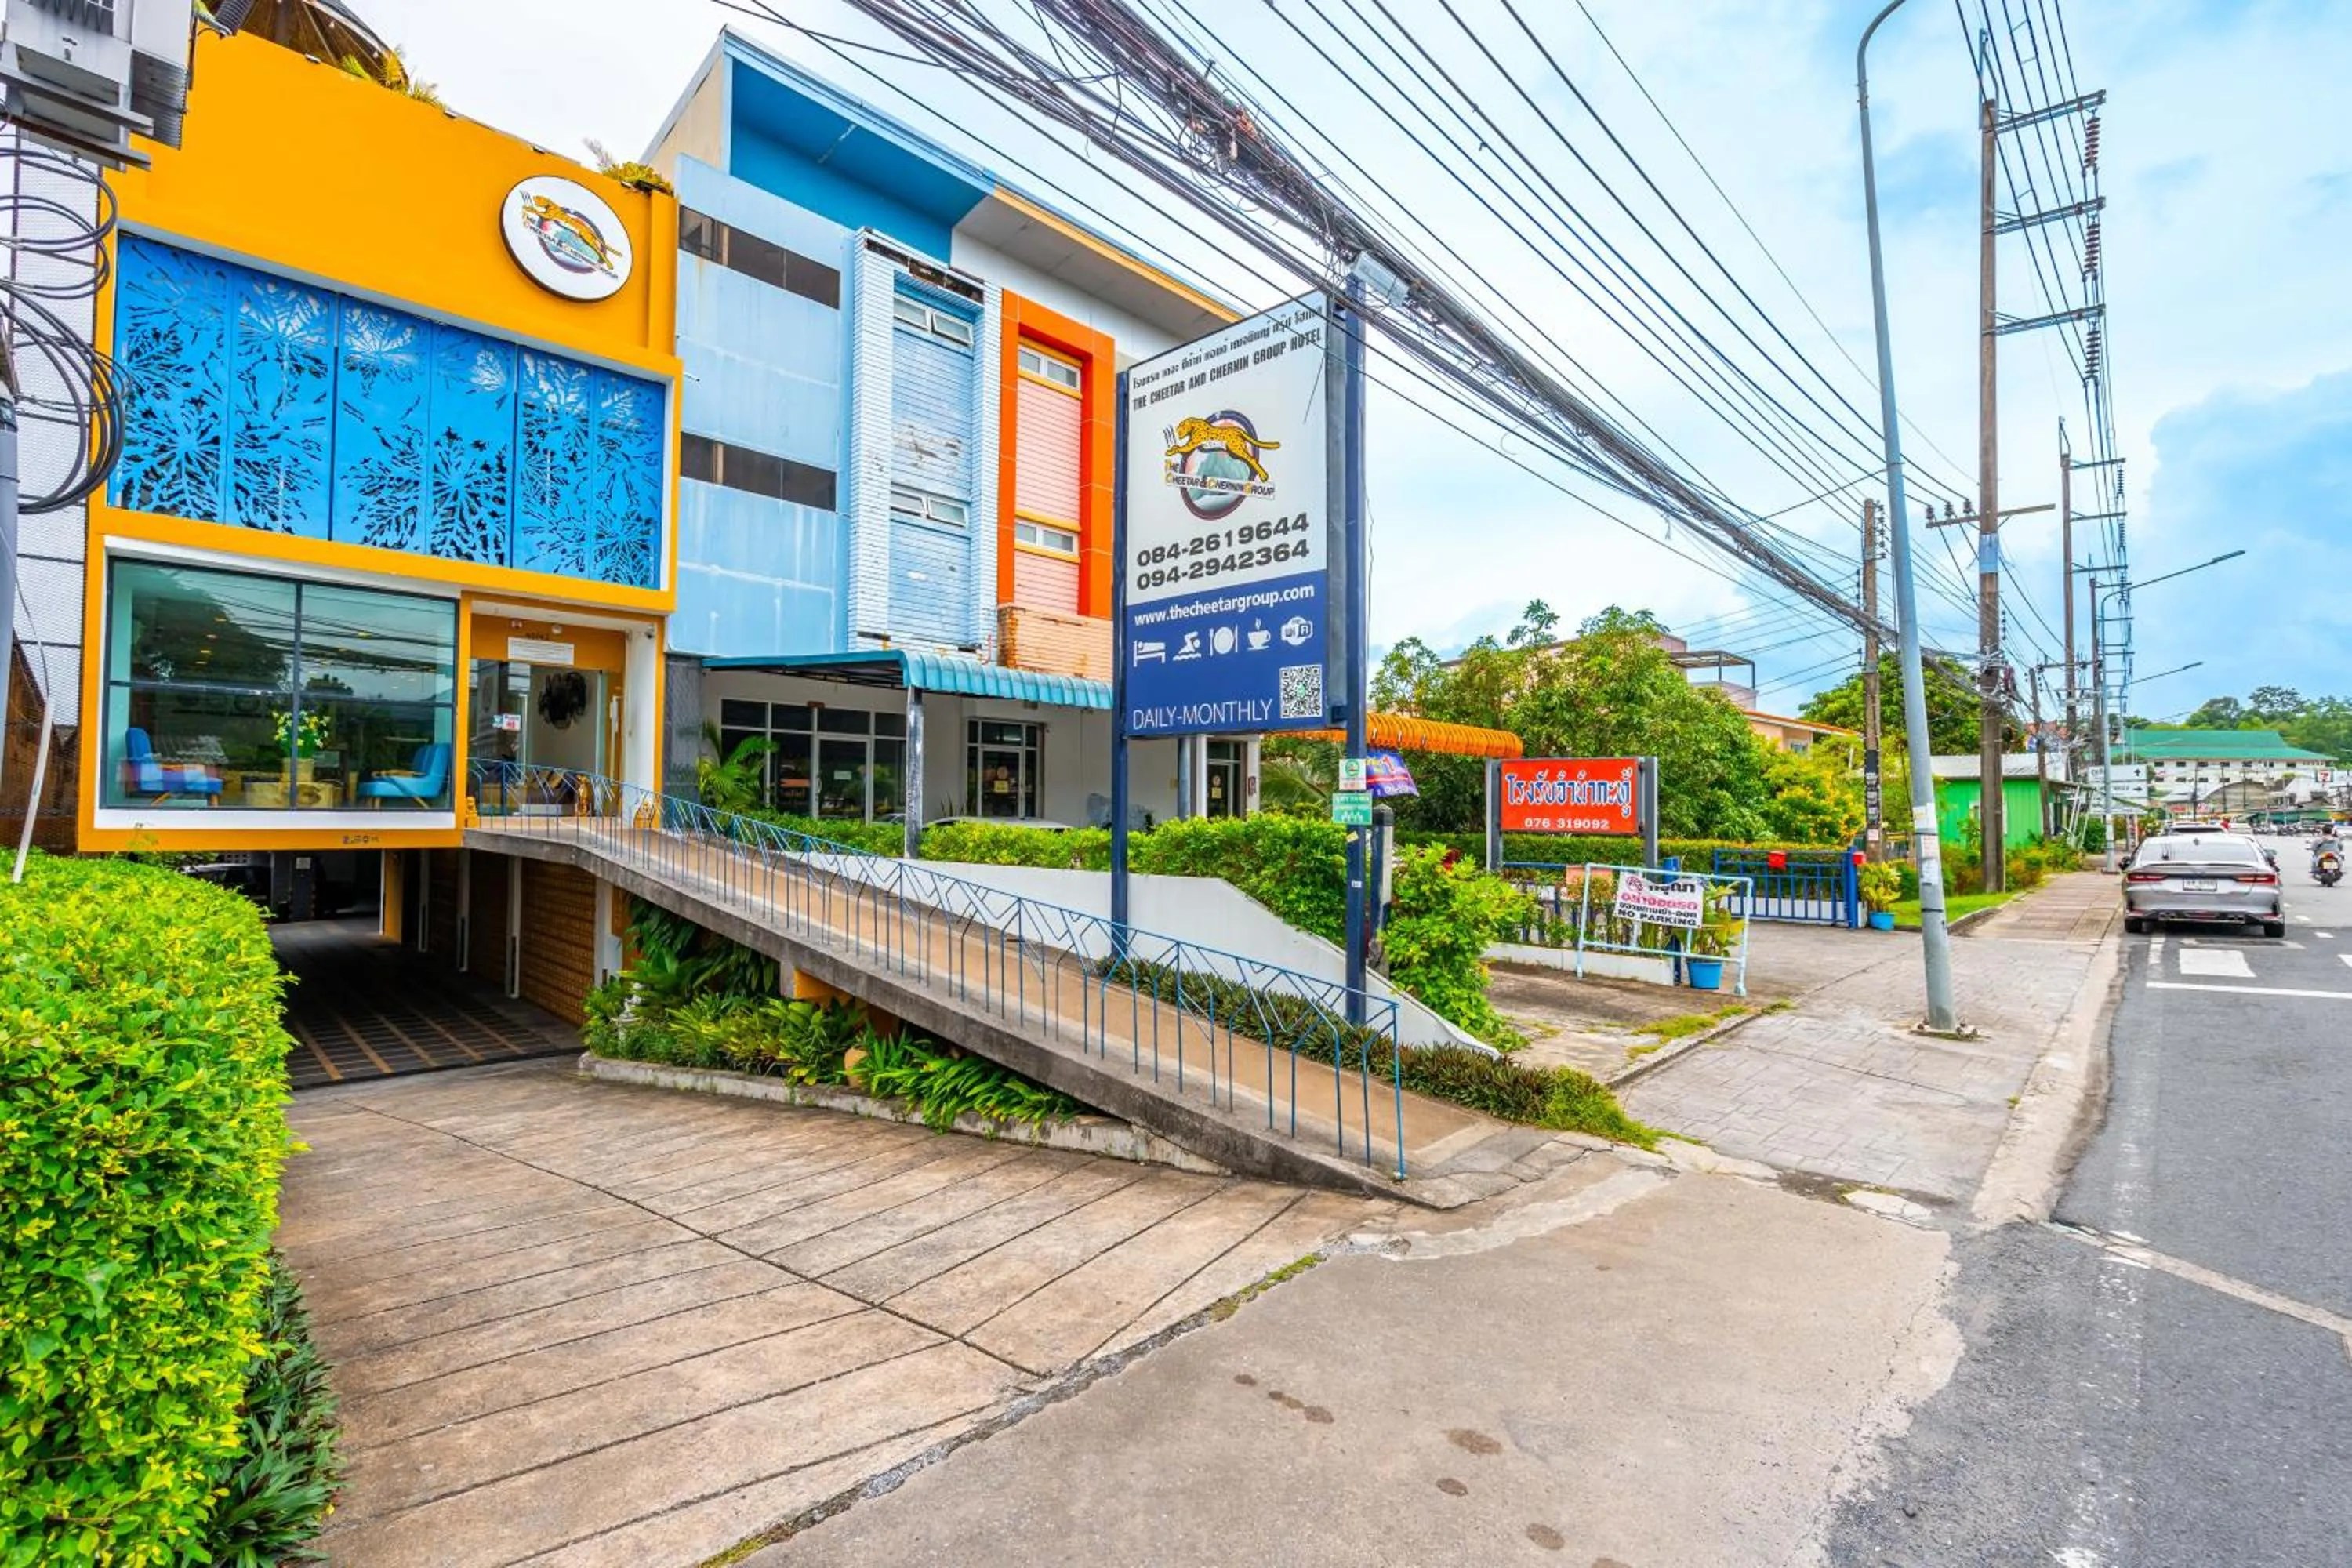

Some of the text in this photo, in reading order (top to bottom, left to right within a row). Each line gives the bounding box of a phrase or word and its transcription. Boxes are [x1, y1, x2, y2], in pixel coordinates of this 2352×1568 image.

[1132, 328, 1321, 411] THE CHEETAR AND CHERNIN GROUP HOTEL
[1137, 513, 1309, 567] 084-2619644
[1137, 539, 1310, 590] 094-2942364
[1134, 585, 1315, 626] www.thecheetargroup.com
[1133, 699, 1272, 729] DAILY-MONTHLY
[1505, 767, 1632, 818] โรงรับจำนำกะทู้
[1524, 818, 1610, 829] 076 319092
[1618, 909, 1696, 925] NO PARKING
